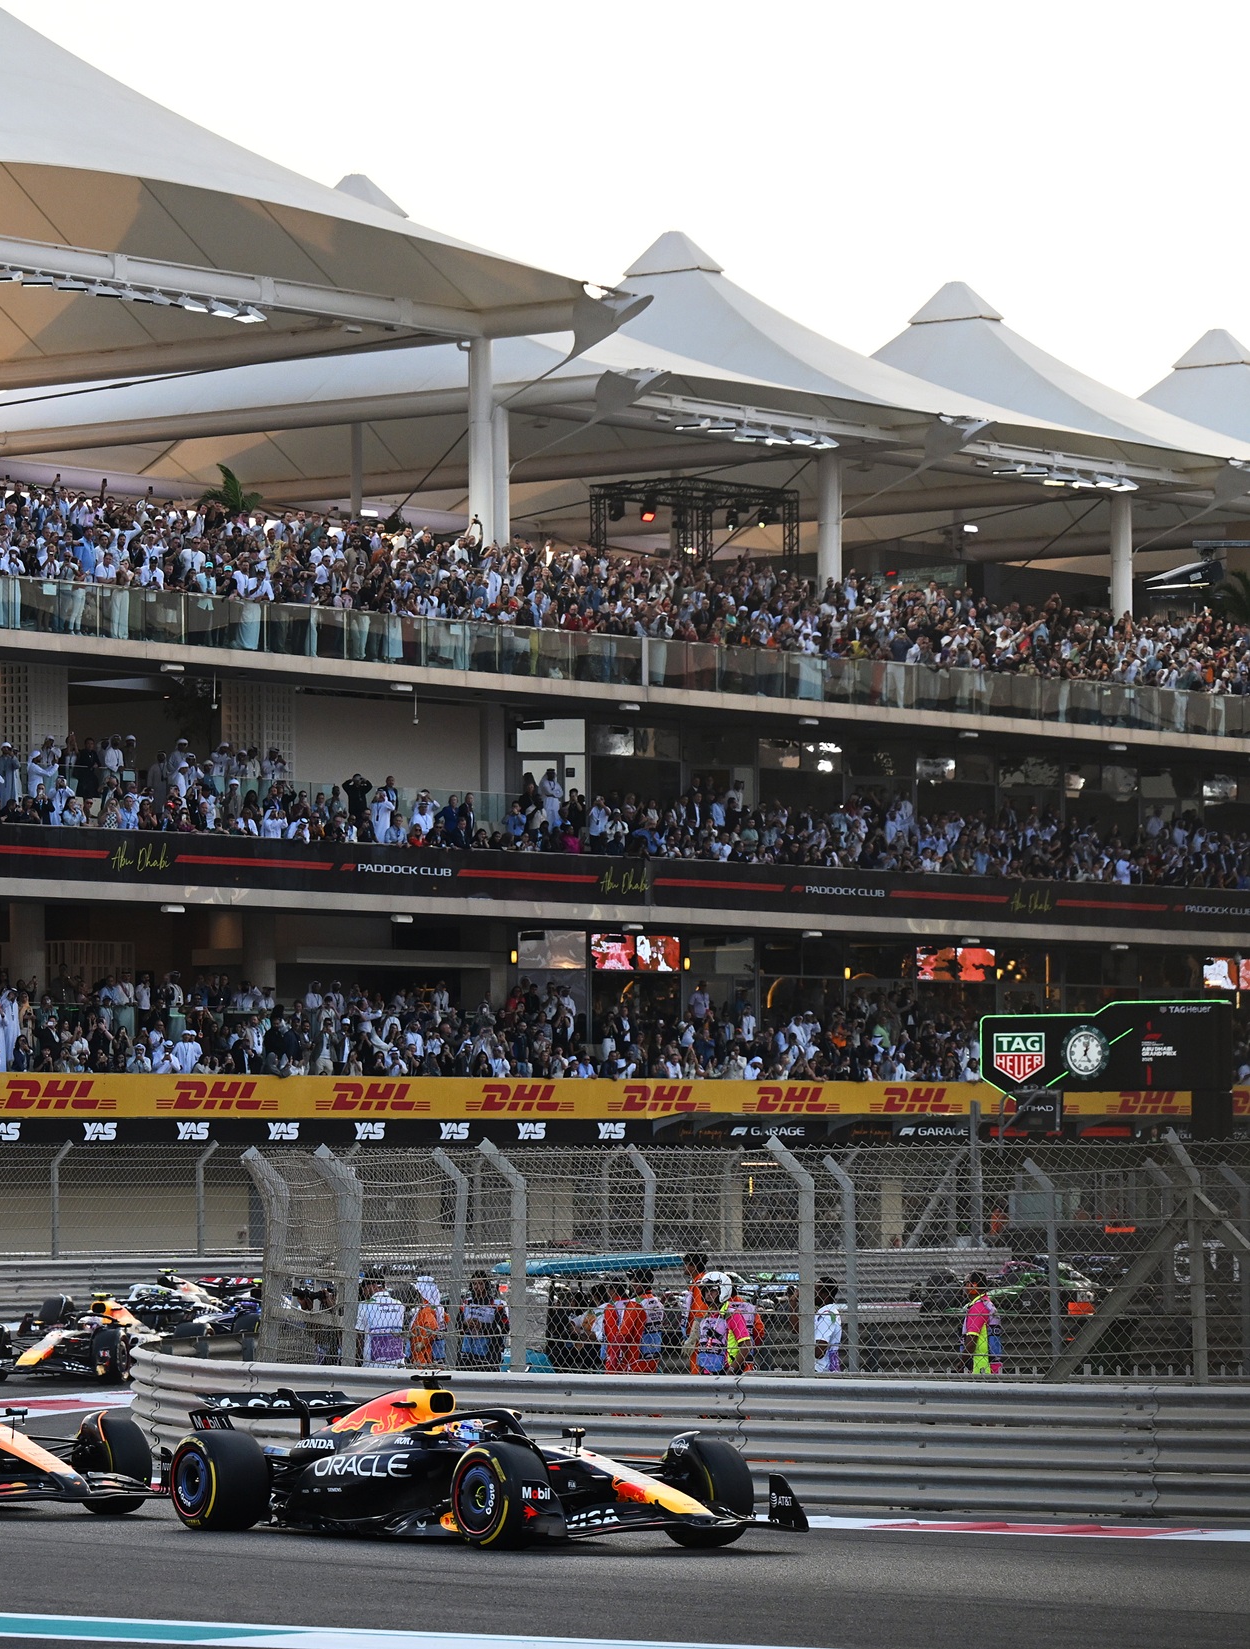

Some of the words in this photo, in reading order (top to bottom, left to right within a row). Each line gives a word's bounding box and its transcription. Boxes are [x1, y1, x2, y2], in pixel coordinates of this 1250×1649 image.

[111, 840, 134, 872] Abu
[136, 842, 171, 872] Dhabi
[357, 863, 418, 875] PADDOCK
[420, 866, 452, 877] CLUB
[805, 885, 856, 896] PADDOCK
[858, 887, 885, 898] CLUB
[1185, 904, 1229, 914] PADDOCK
[998, 1036, 1040, 1051] TAG
[996, 1055, 1042, 1079] HEUER
[4, 1080, 99, 1110] DHL
[173, 1081, 262, 1110] DHL
[331, 1083, 415, 1111] DHL
[481, 1084, 559, 1112] DHL
[622, 1086, 696, 1112] DHL
[756, 1087, 826, 1113] DHL
[883, 1088, 949, 1113] DHL
[1118, 1091, 1180, 1114] DHL
[83, 1122, 117, 1141] YAS
[176, 1122, 210, 1140] YAS
[267, 1122, 300, 1140] YAS
[354, 1122, 386, 1140] YAS
[439, 1122, 470, 1140] YAS
[517, 1122, 547, 1140] YAS
[597, 1122, 626, 1140] YAS
[192, 1414, 221, 1429] Mobil
[294, 1438, 335, 1450] HONDA
[314, 1453, 412, 1478] ORACLE
[522, 1486, 551, 1500] Mobil
[777, 1495, 793, 1507] AT&T
